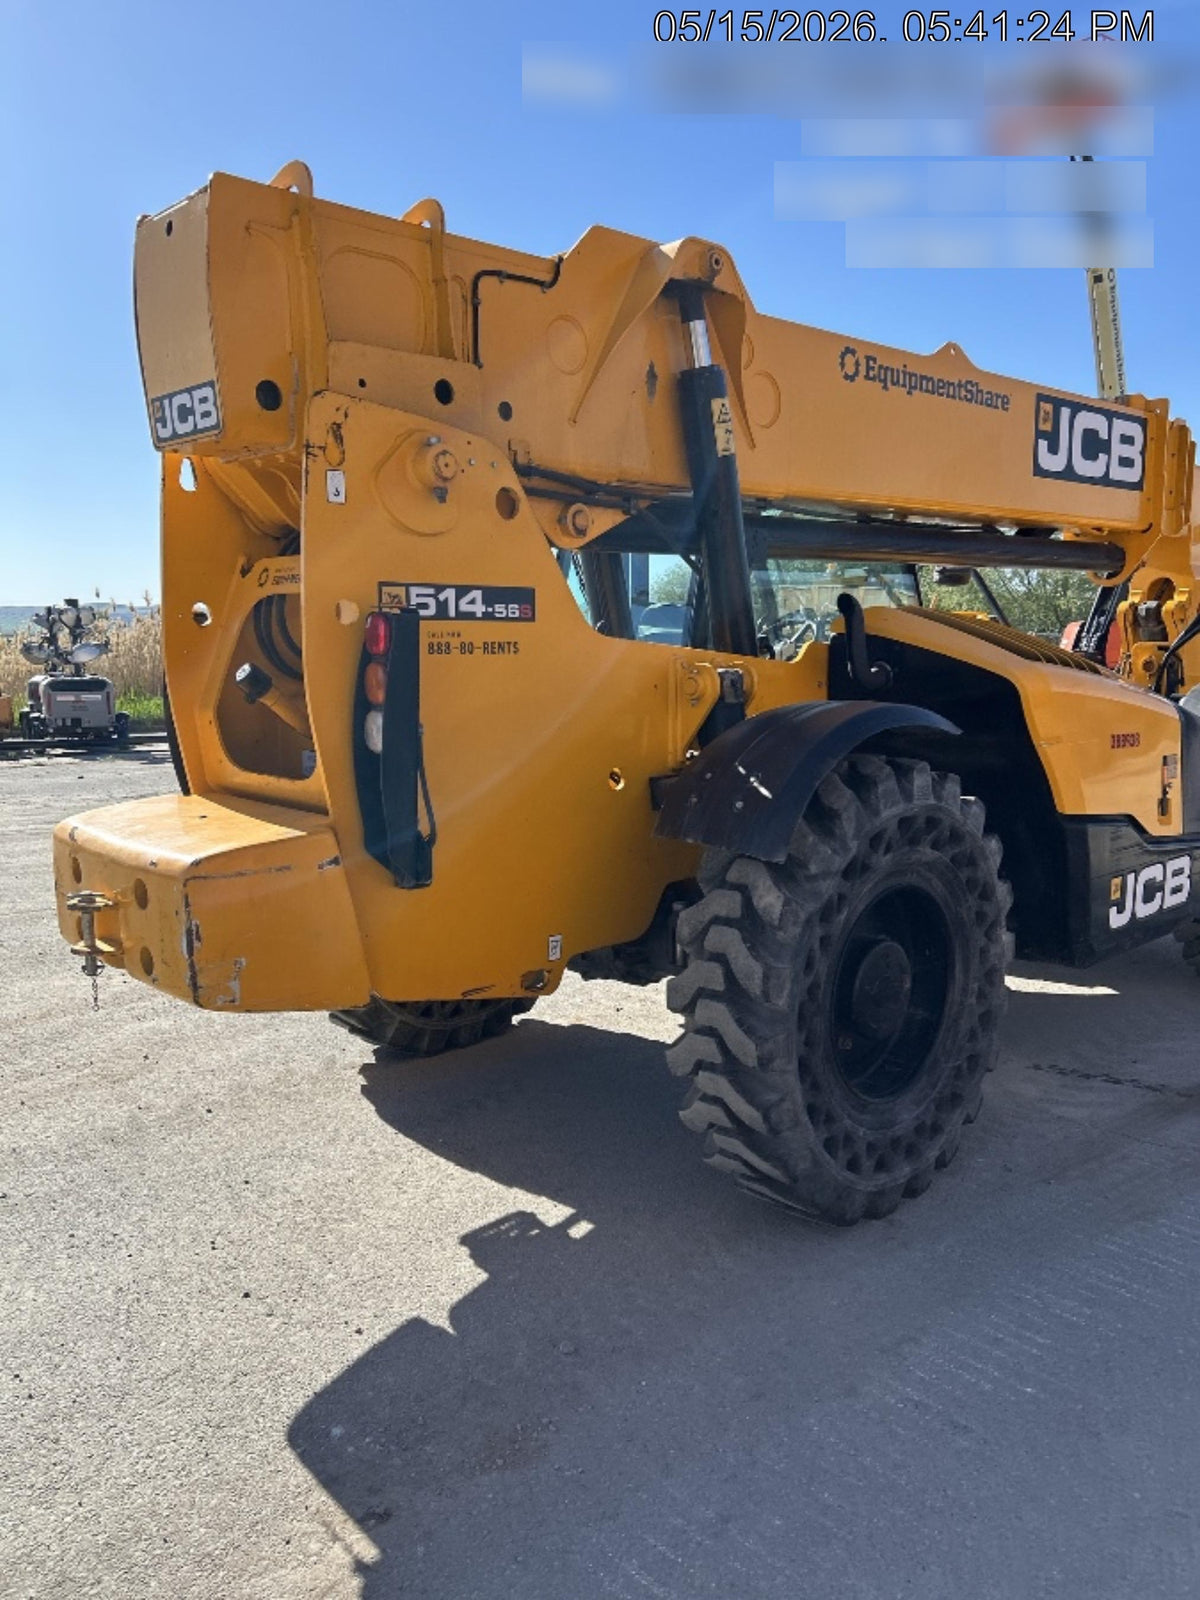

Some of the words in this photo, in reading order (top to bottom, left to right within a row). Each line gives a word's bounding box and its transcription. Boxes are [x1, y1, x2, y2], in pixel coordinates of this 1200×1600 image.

[863, 354, 1012, 412] EquipmentShare
[156, 386, 218, 439] JCB
[1038, 406, 1144, 483] JCB
[427, 641, 520, 655] 888-80-RENTS
[1109, 854, 1191, 929] JCB
